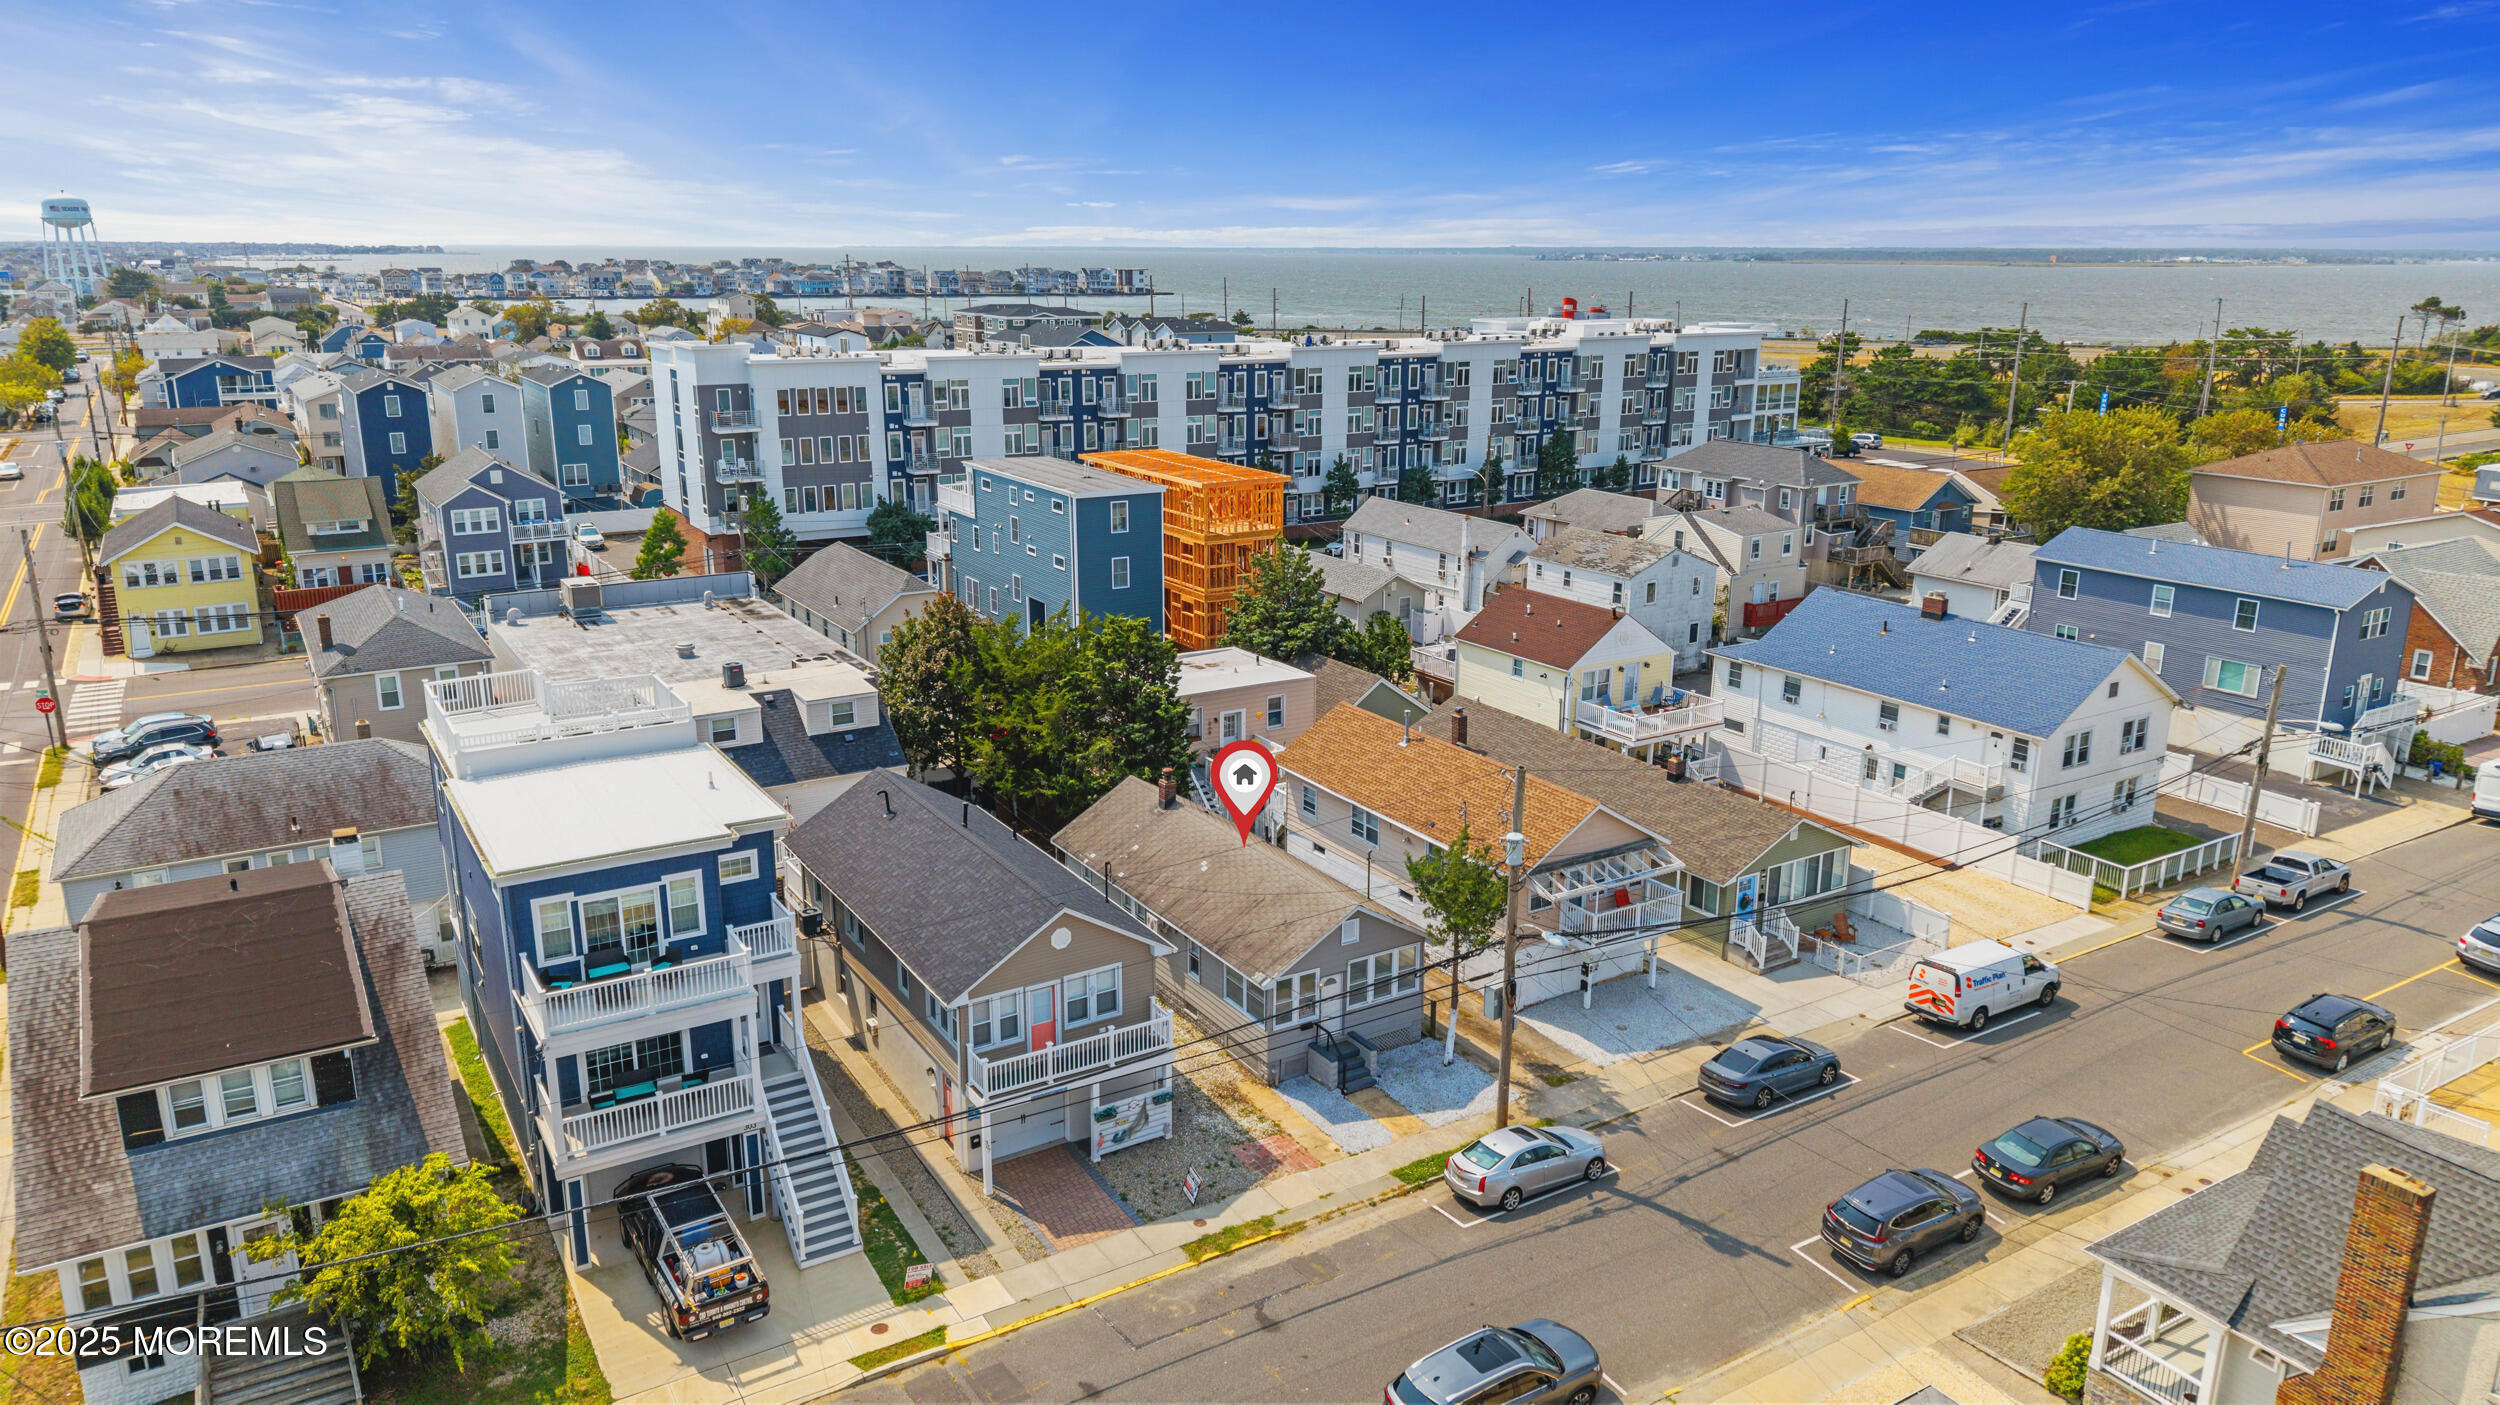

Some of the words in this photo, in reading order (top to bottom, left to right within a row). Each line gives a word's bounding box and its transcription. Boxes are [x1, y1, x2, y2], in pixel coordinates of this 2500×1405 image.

[36, 702, 55, 710] STOP
[1973, 976, 1992, 987] Traffic
[1992, 971, 2006, 981] Plan
